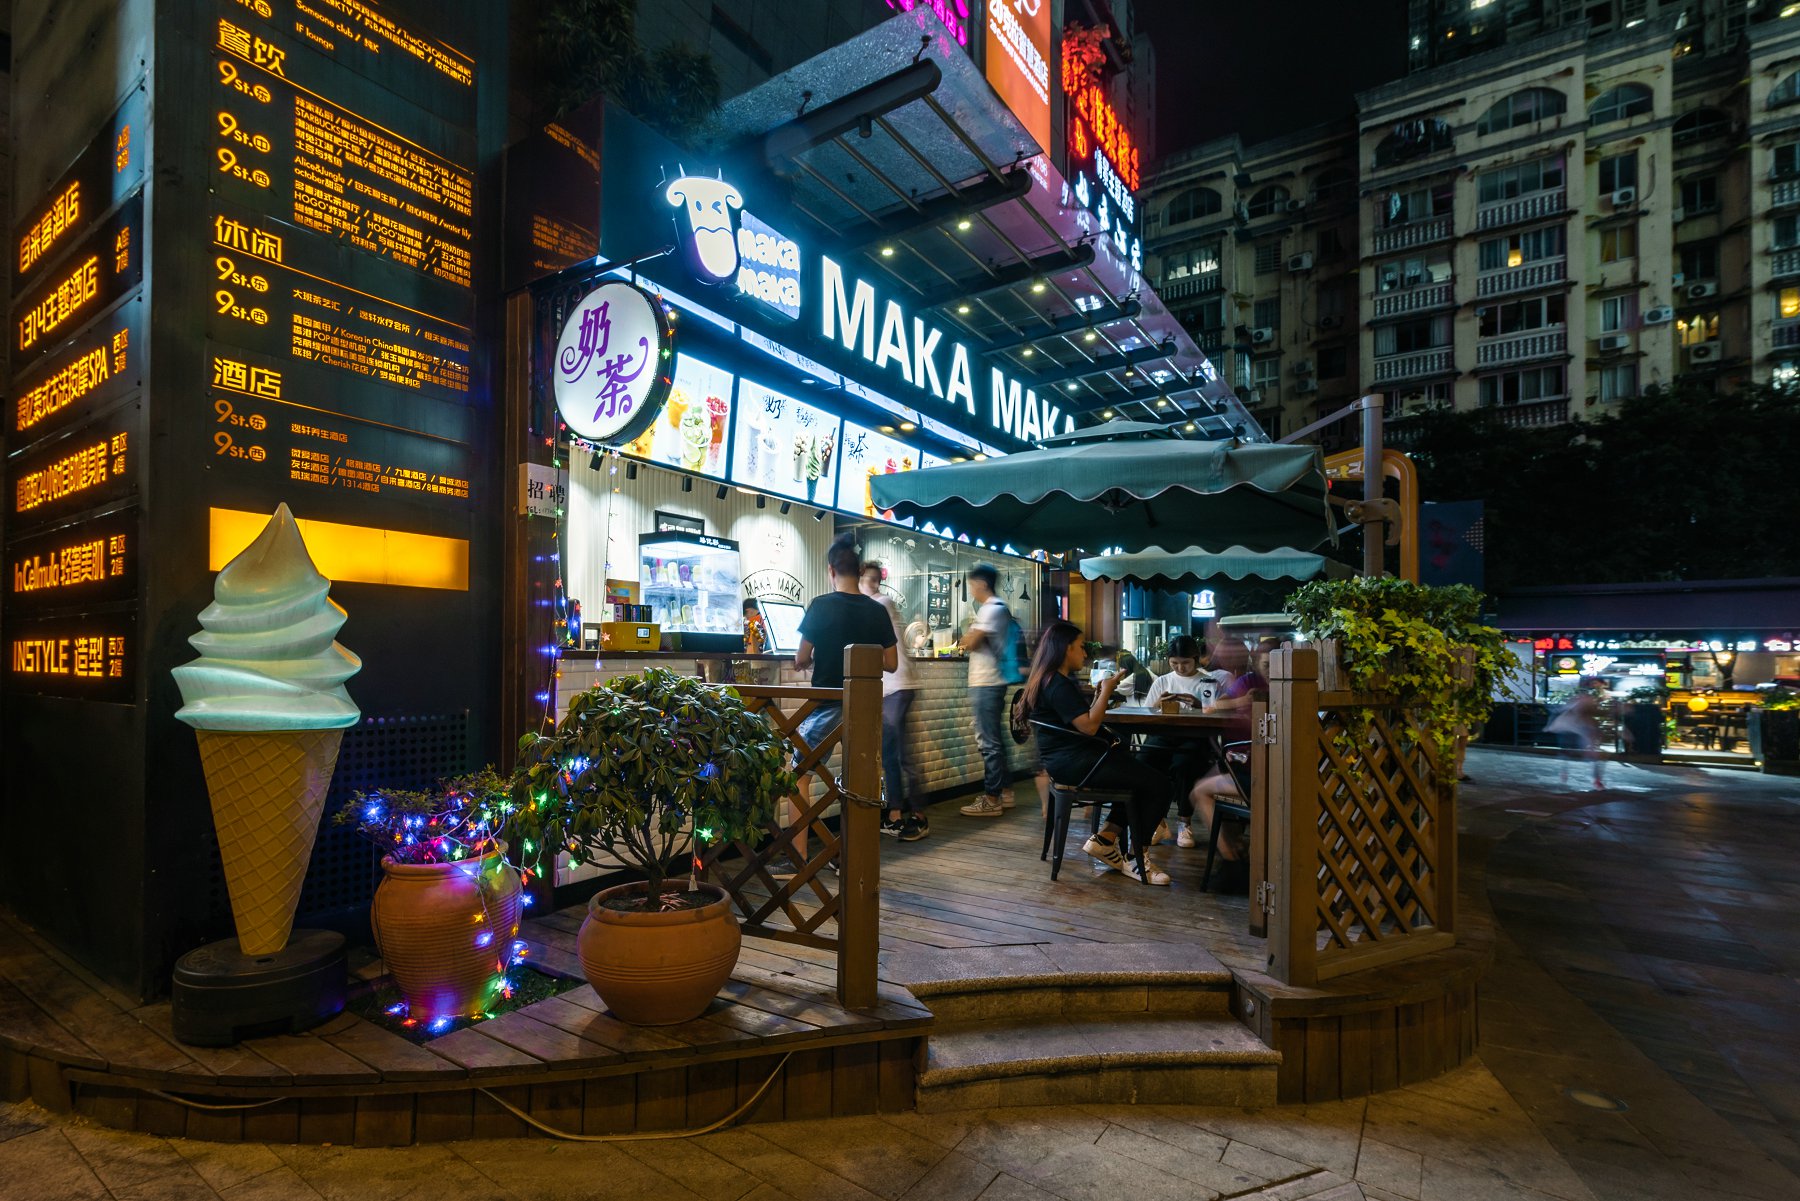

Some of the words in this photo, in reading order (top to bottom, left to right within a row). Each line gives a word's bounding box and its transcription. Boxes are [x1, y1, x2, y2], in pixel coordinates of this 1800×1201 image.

[219, 19, 285, 76] 餐饮
[305, 27, 334, 52] lounge
[336, 20, 352, 39] club
[294, 153, 345, 185] Alice&Jungle
[19, 180, 81, 274] 自来客酒店
[214, 215, 282, 263] 休闲
[737, 228, 800, 272] maka
[19, 255, 98, 351] 1314主题酒店
[737, 266, 800, 308] maka
[822, 254, 976, 417] MAKA
[213, 357, 282, 399] 酒店
[560, 300, 649, 424] 奶茶
[342, 478, 380, 493] 1314酒店
[527, 479, 566, 504] 招聘
[109, 533, 126, 555] 西区
[778, 577, 801, 601] MAKA
[13, 638, 70, 675] INSTYLE
[74, 636, 104, 678] 造型
[108, 636, 125, 656] 西区
